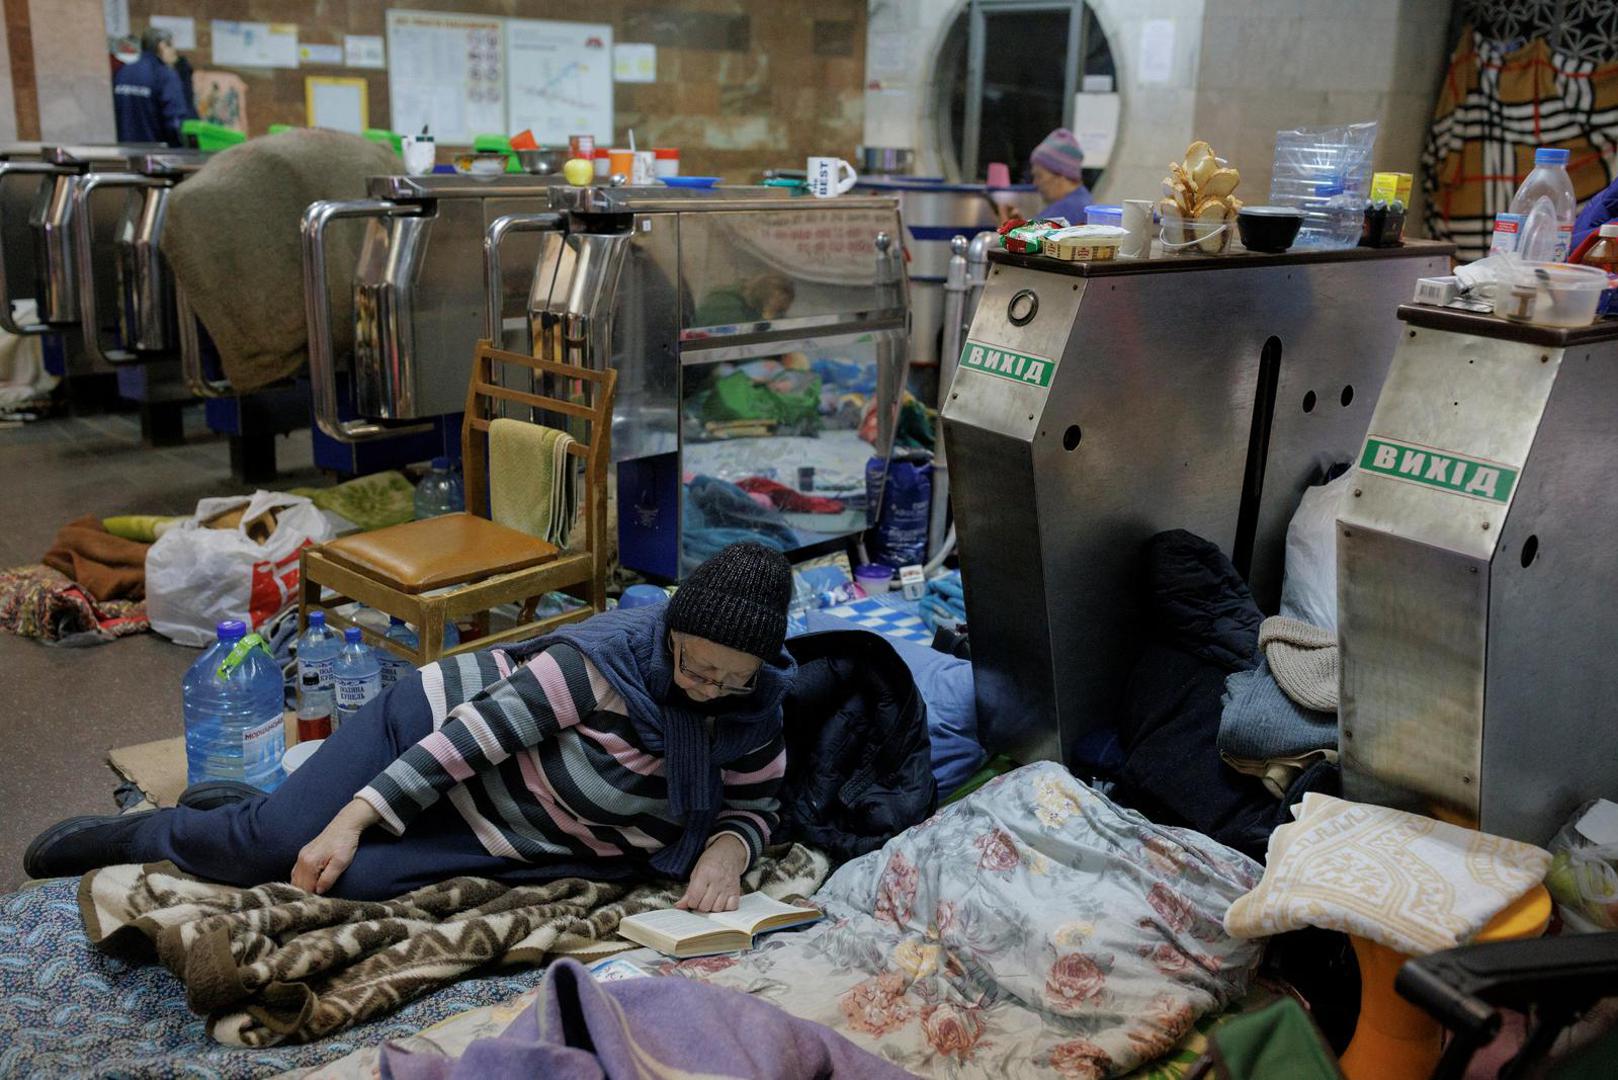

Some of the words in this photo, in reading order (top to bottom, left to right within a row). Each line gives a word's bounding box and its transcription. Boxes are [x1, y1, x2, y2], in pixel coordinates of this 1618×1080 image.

[820, 161, 829, 195] BEST
[968, 346, 1045, 384] ВИХІД
[1373, 444, 1500, 498] ВИХІД
